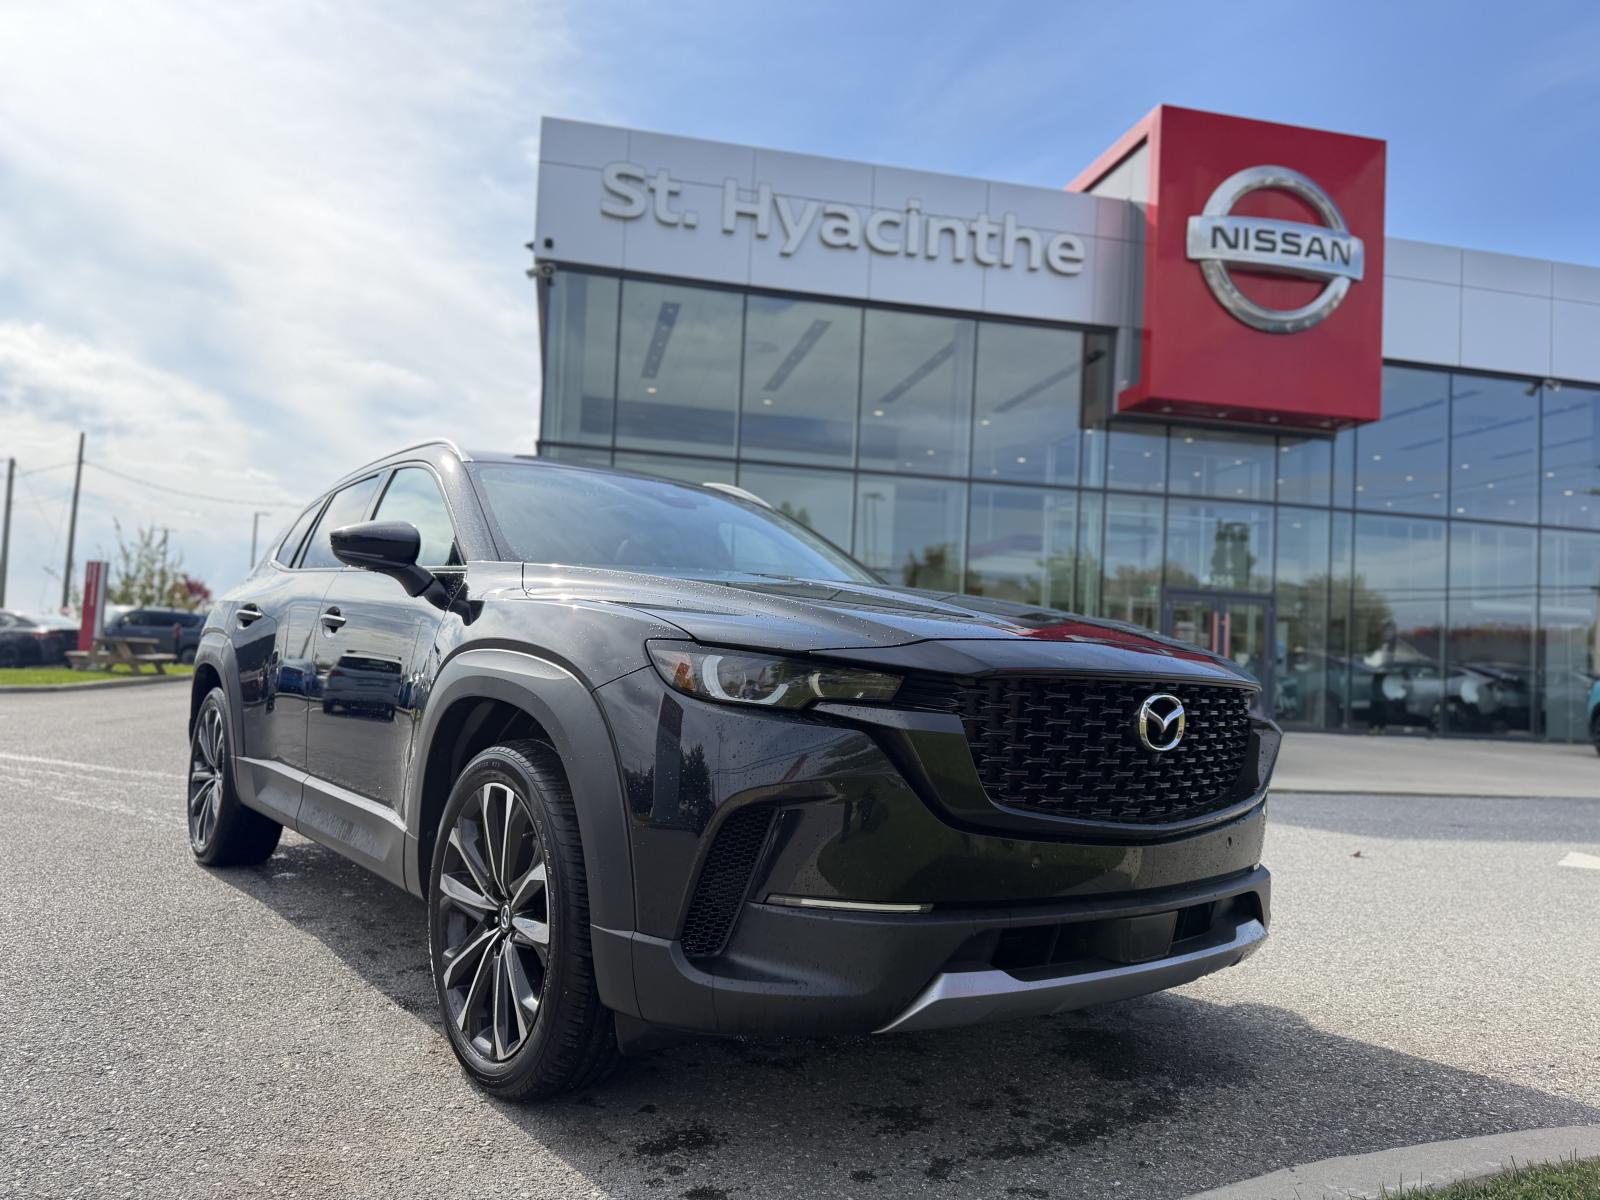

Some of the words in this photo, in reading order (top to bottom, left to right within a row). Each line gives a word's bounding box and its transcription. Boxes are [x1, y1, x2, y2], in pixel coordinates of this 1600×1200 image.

[601, 162, 697, 230] St.
[722, 178, 1085, 276] Hyacinthe
[1211, 226, 1350, 266] NISSAN
